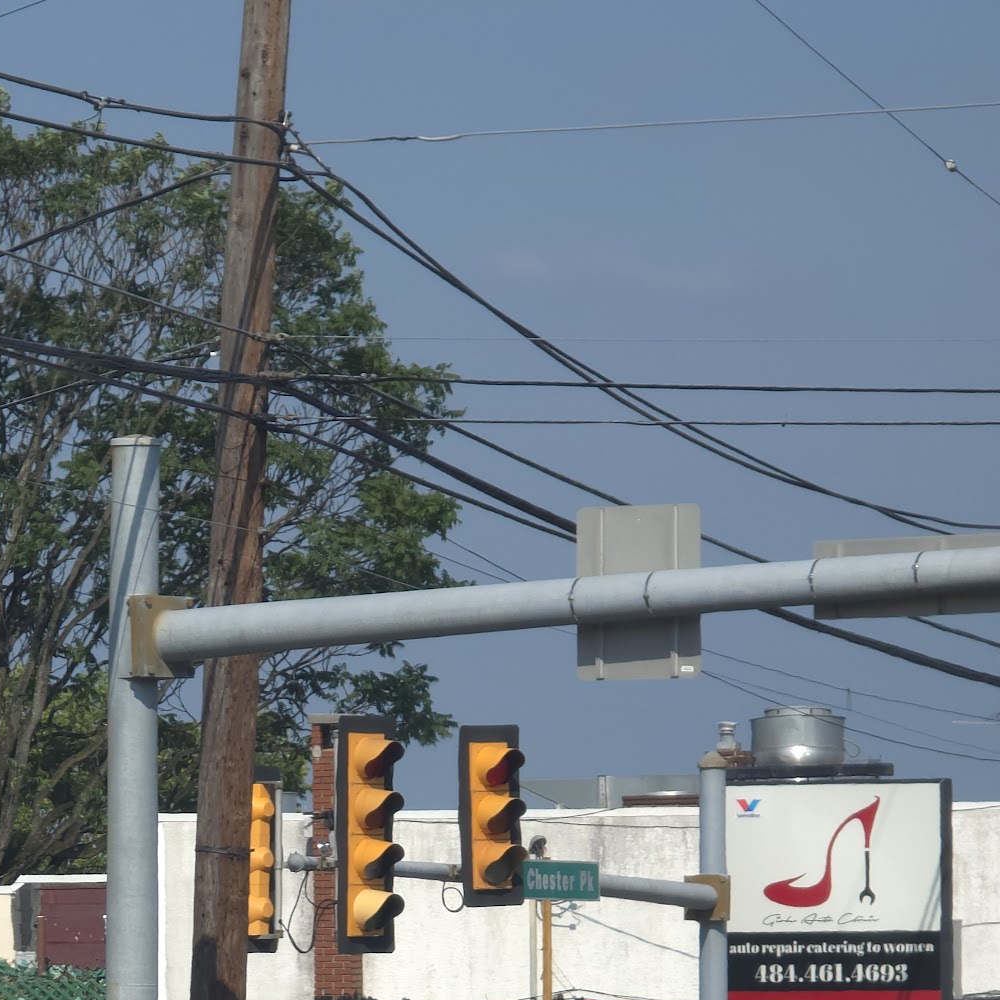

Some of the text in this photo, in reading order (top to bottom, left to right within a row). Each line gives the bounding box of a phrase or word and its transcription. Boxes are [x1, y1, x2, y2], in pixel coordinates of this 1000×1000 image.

[526, 867, 594, 892] Chester Pk
[729, 940, 934, 957] auto repair catering to women
[754, 963, 909, 983] 484.461.4693
